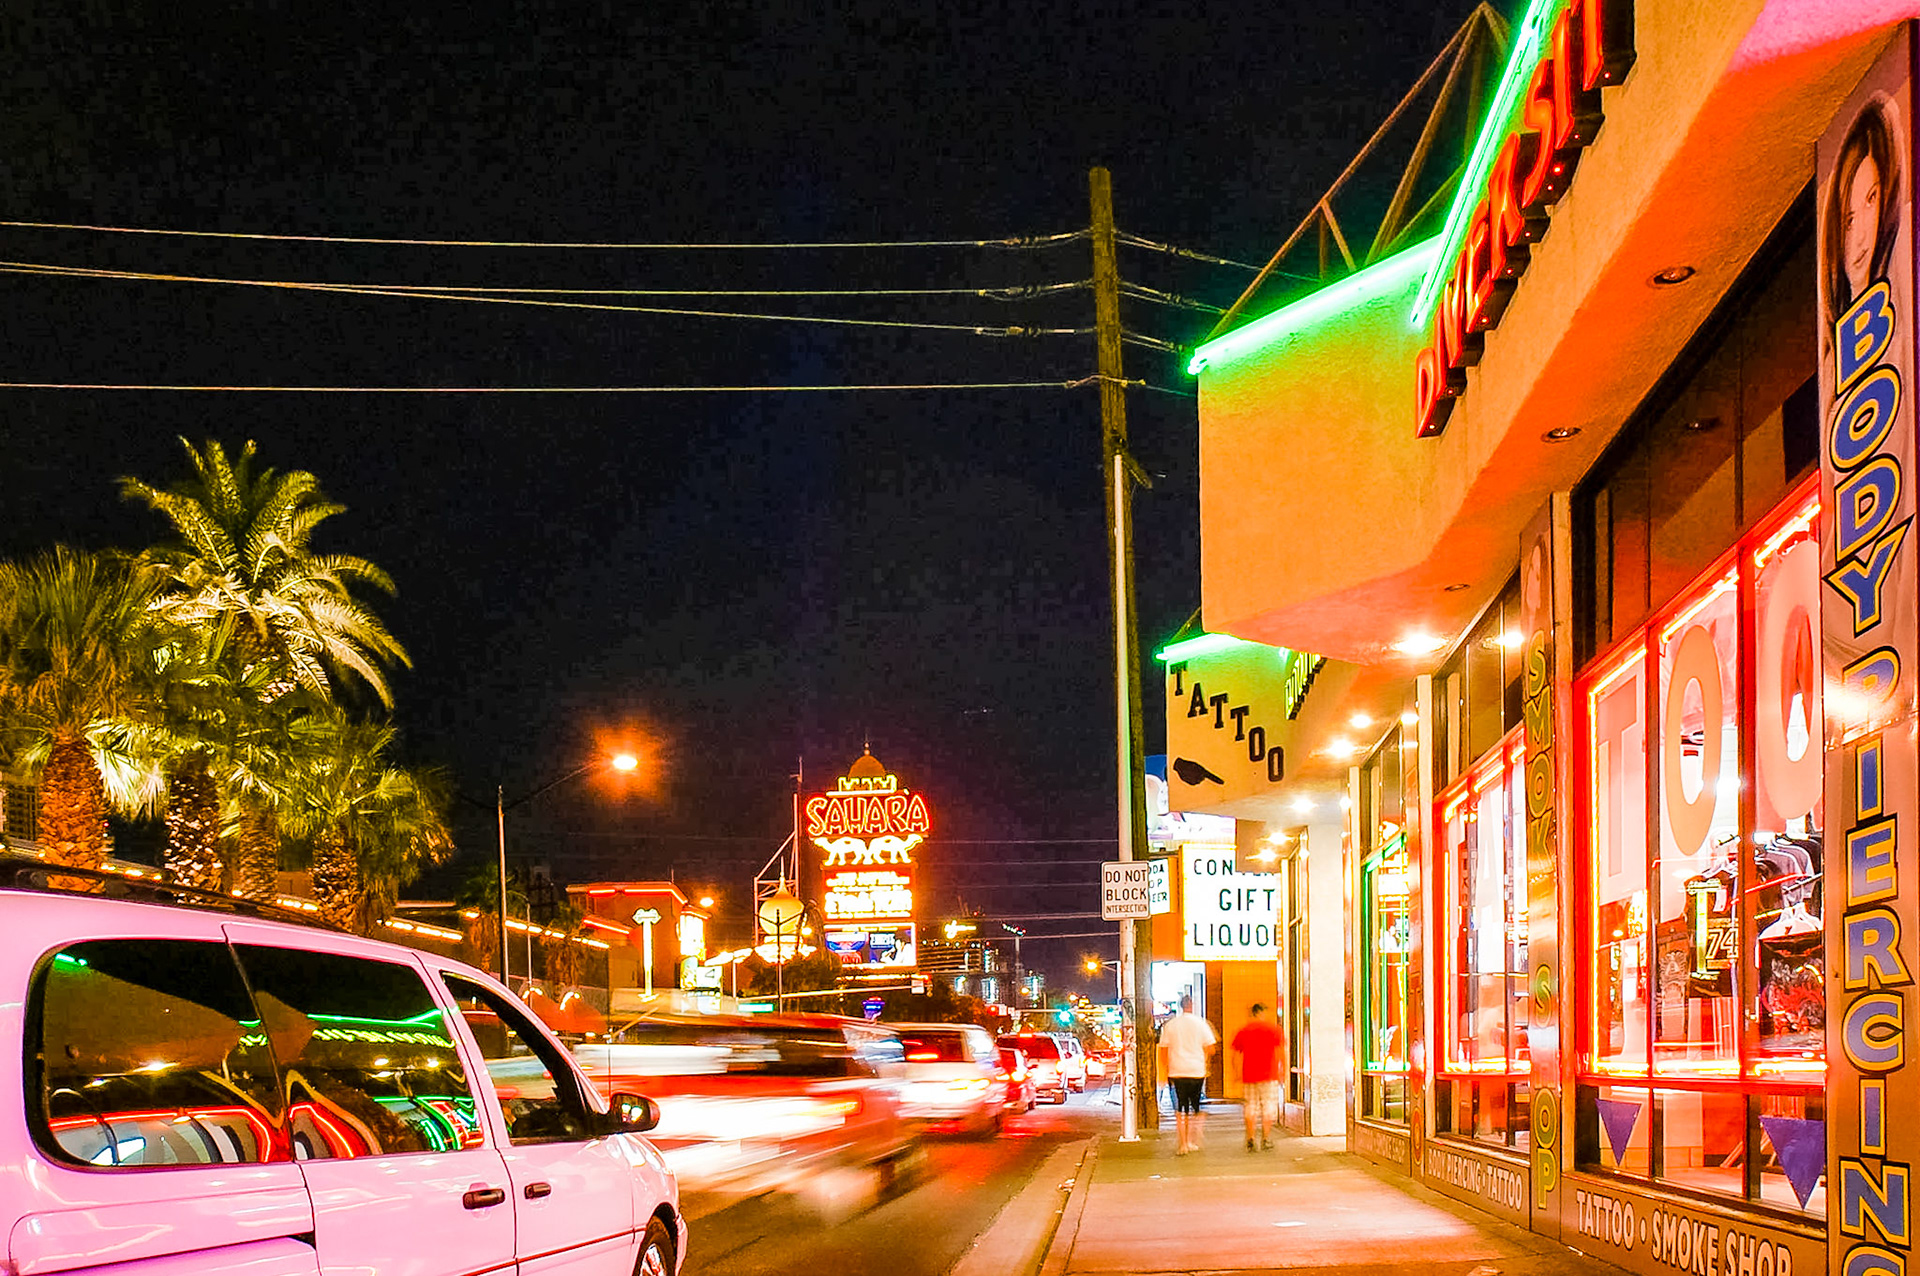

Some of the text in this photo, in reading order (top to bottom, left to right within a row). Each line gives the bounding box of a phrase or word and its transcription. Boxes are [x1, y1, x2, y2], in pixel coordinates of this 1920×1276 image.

[1822, 276, 1915, 638] BODY
[1170, 661, 1284, 782] TATTOO
[806, 795, 930, 836] SAHARA
[1105, 869, 1147, 883] DO NOT
[1106, 888, 1147, 901] BLOCK
[1106, 903, 1148, 914] INTERSECTION
[1219, 888, 1275, 911] GIFT
[1525, 629, 1558, 1210] SMOK SOP
[1194, 923, 1277, 946] LIQUO
[1447, 1153, 1481, 1195] PIERCING
[1487, 1164, 1523, 1211] TATTOO
[1576, 1189, 1793, 1276] TATTOO SMOKE SHOP
